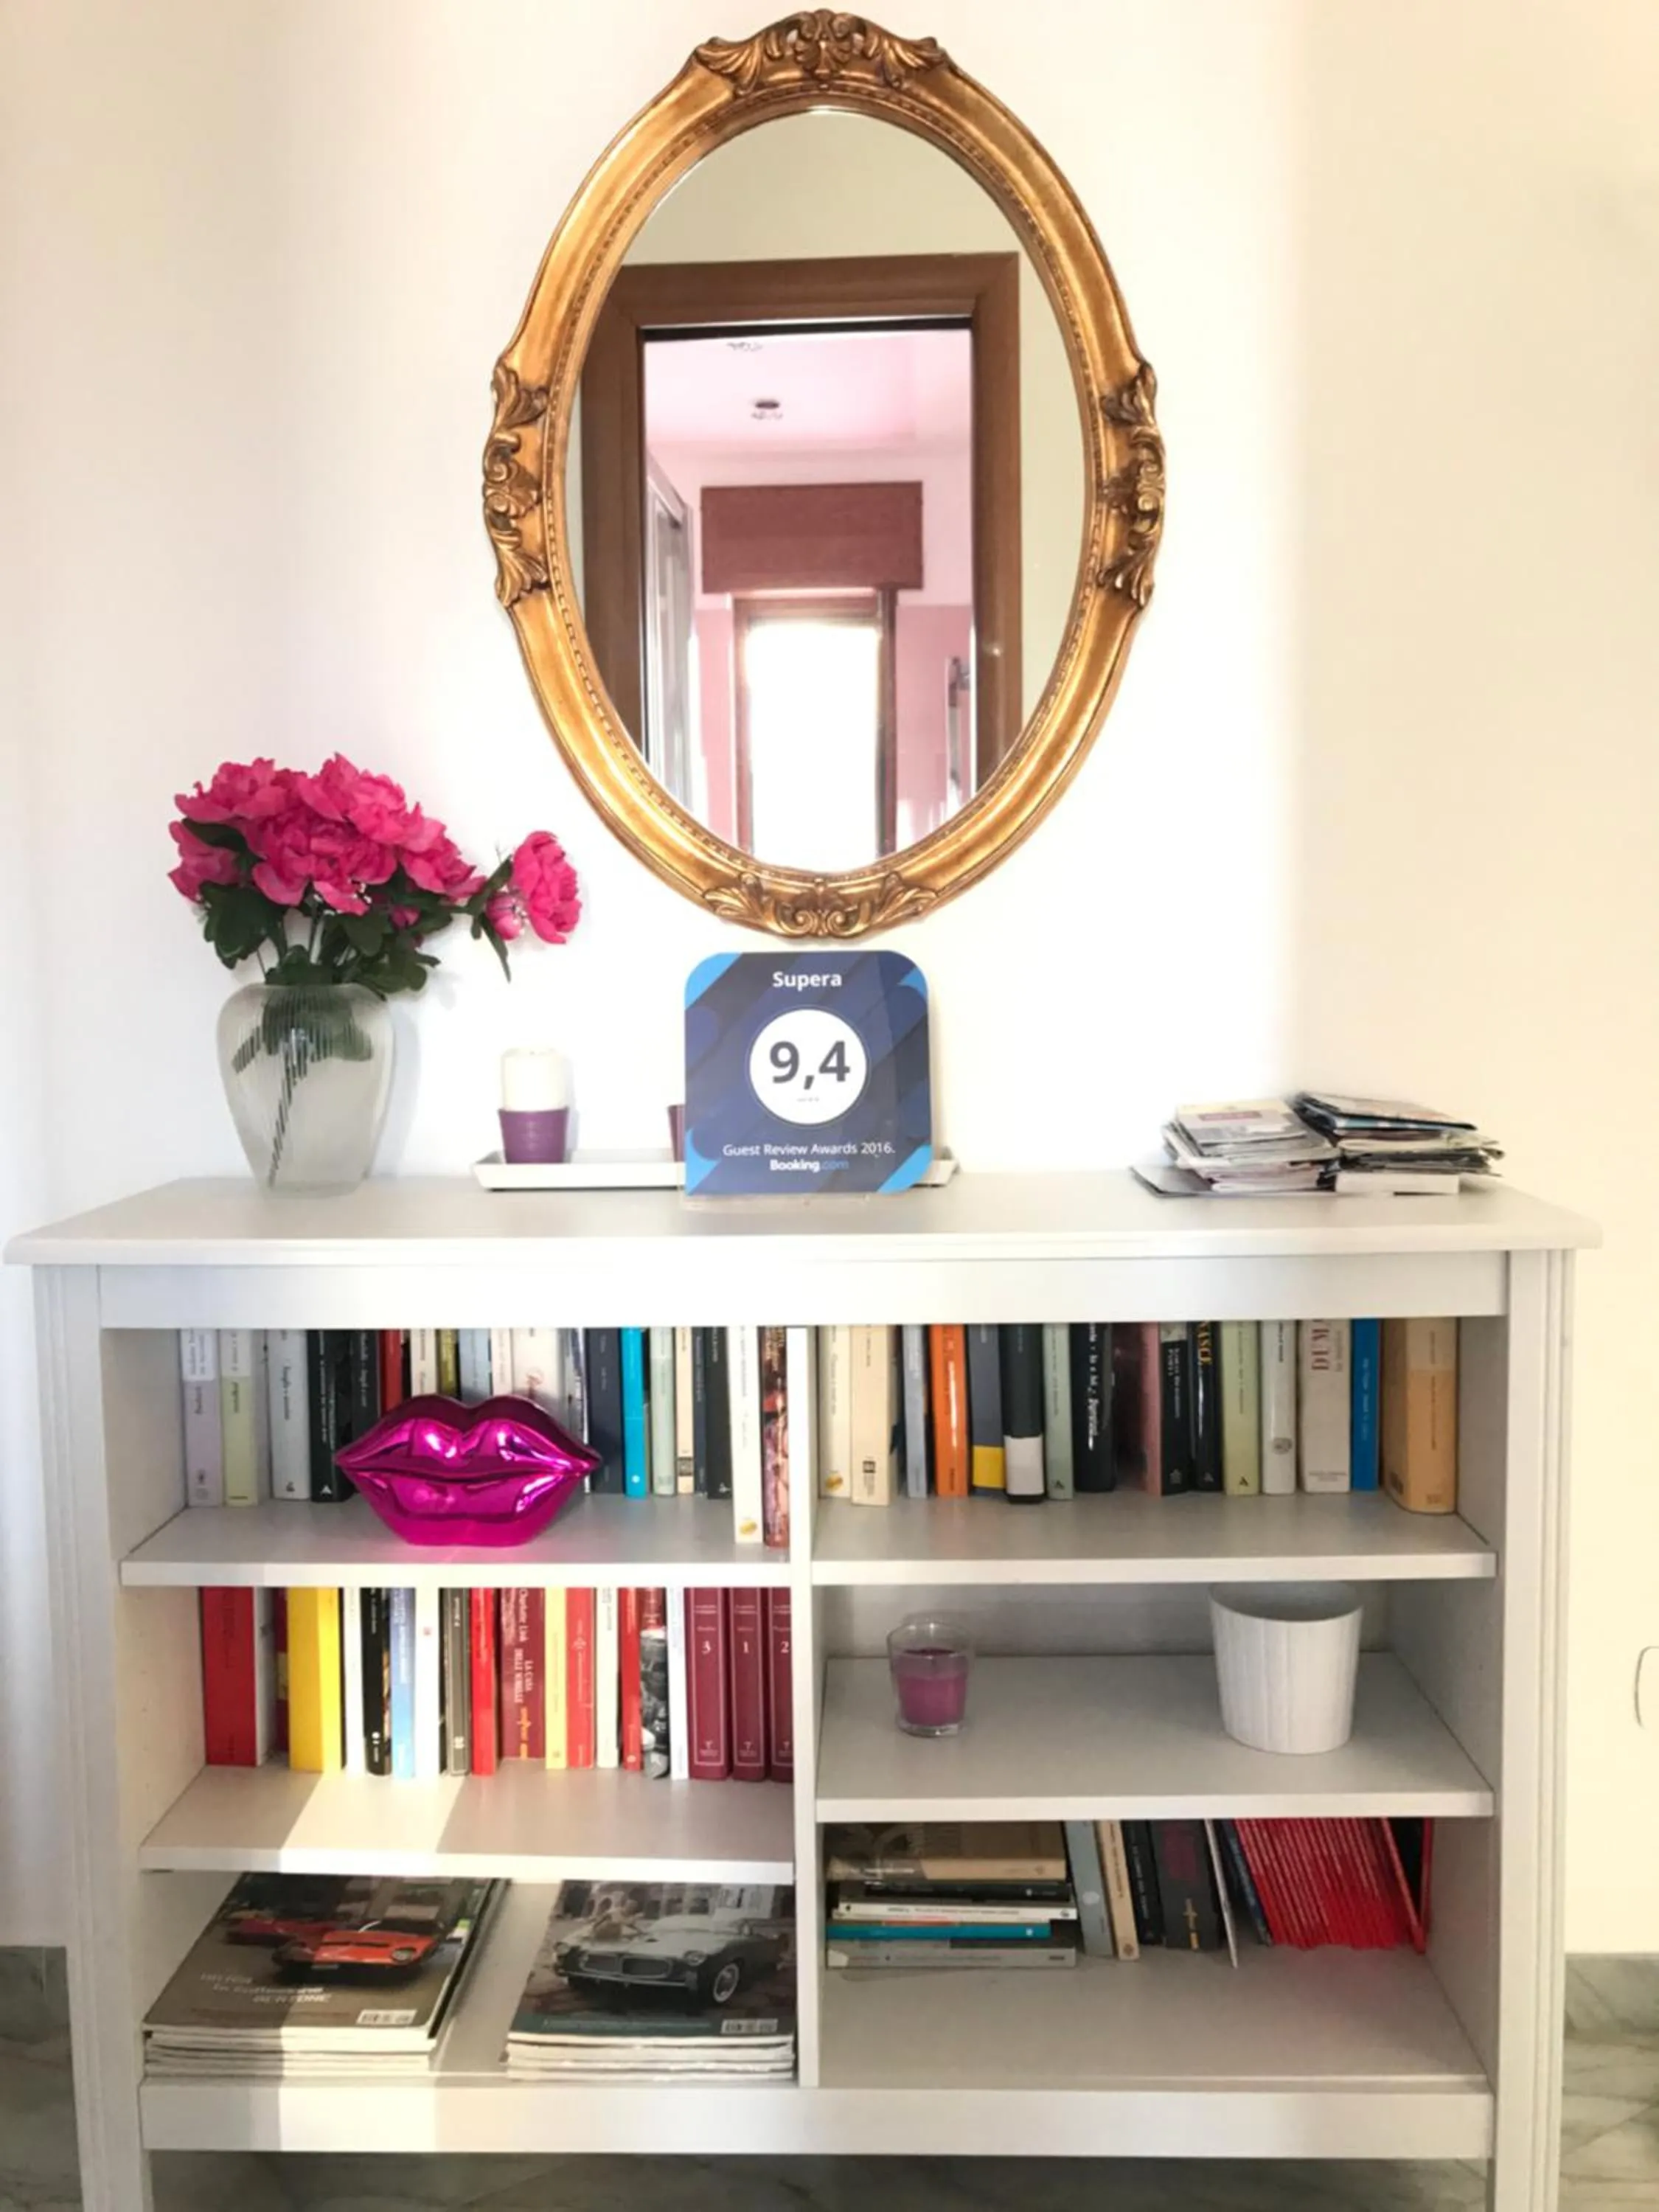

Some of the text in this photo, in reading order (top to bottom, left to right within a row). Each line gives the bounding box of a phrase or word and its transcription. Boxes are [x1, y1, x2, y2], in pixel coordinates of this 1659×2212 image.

[772, 971, 843, 991] Supera
[769, 1040, 850, 1090] 9,4
[723, 1144, 760, 1155] Guest
[764, 1144, 807, 1155] Review
[811, 1142, 857, 1155] Awards
[742, 1641, 749, 1653] 1
[780, 1641, 790, 1653] 2
